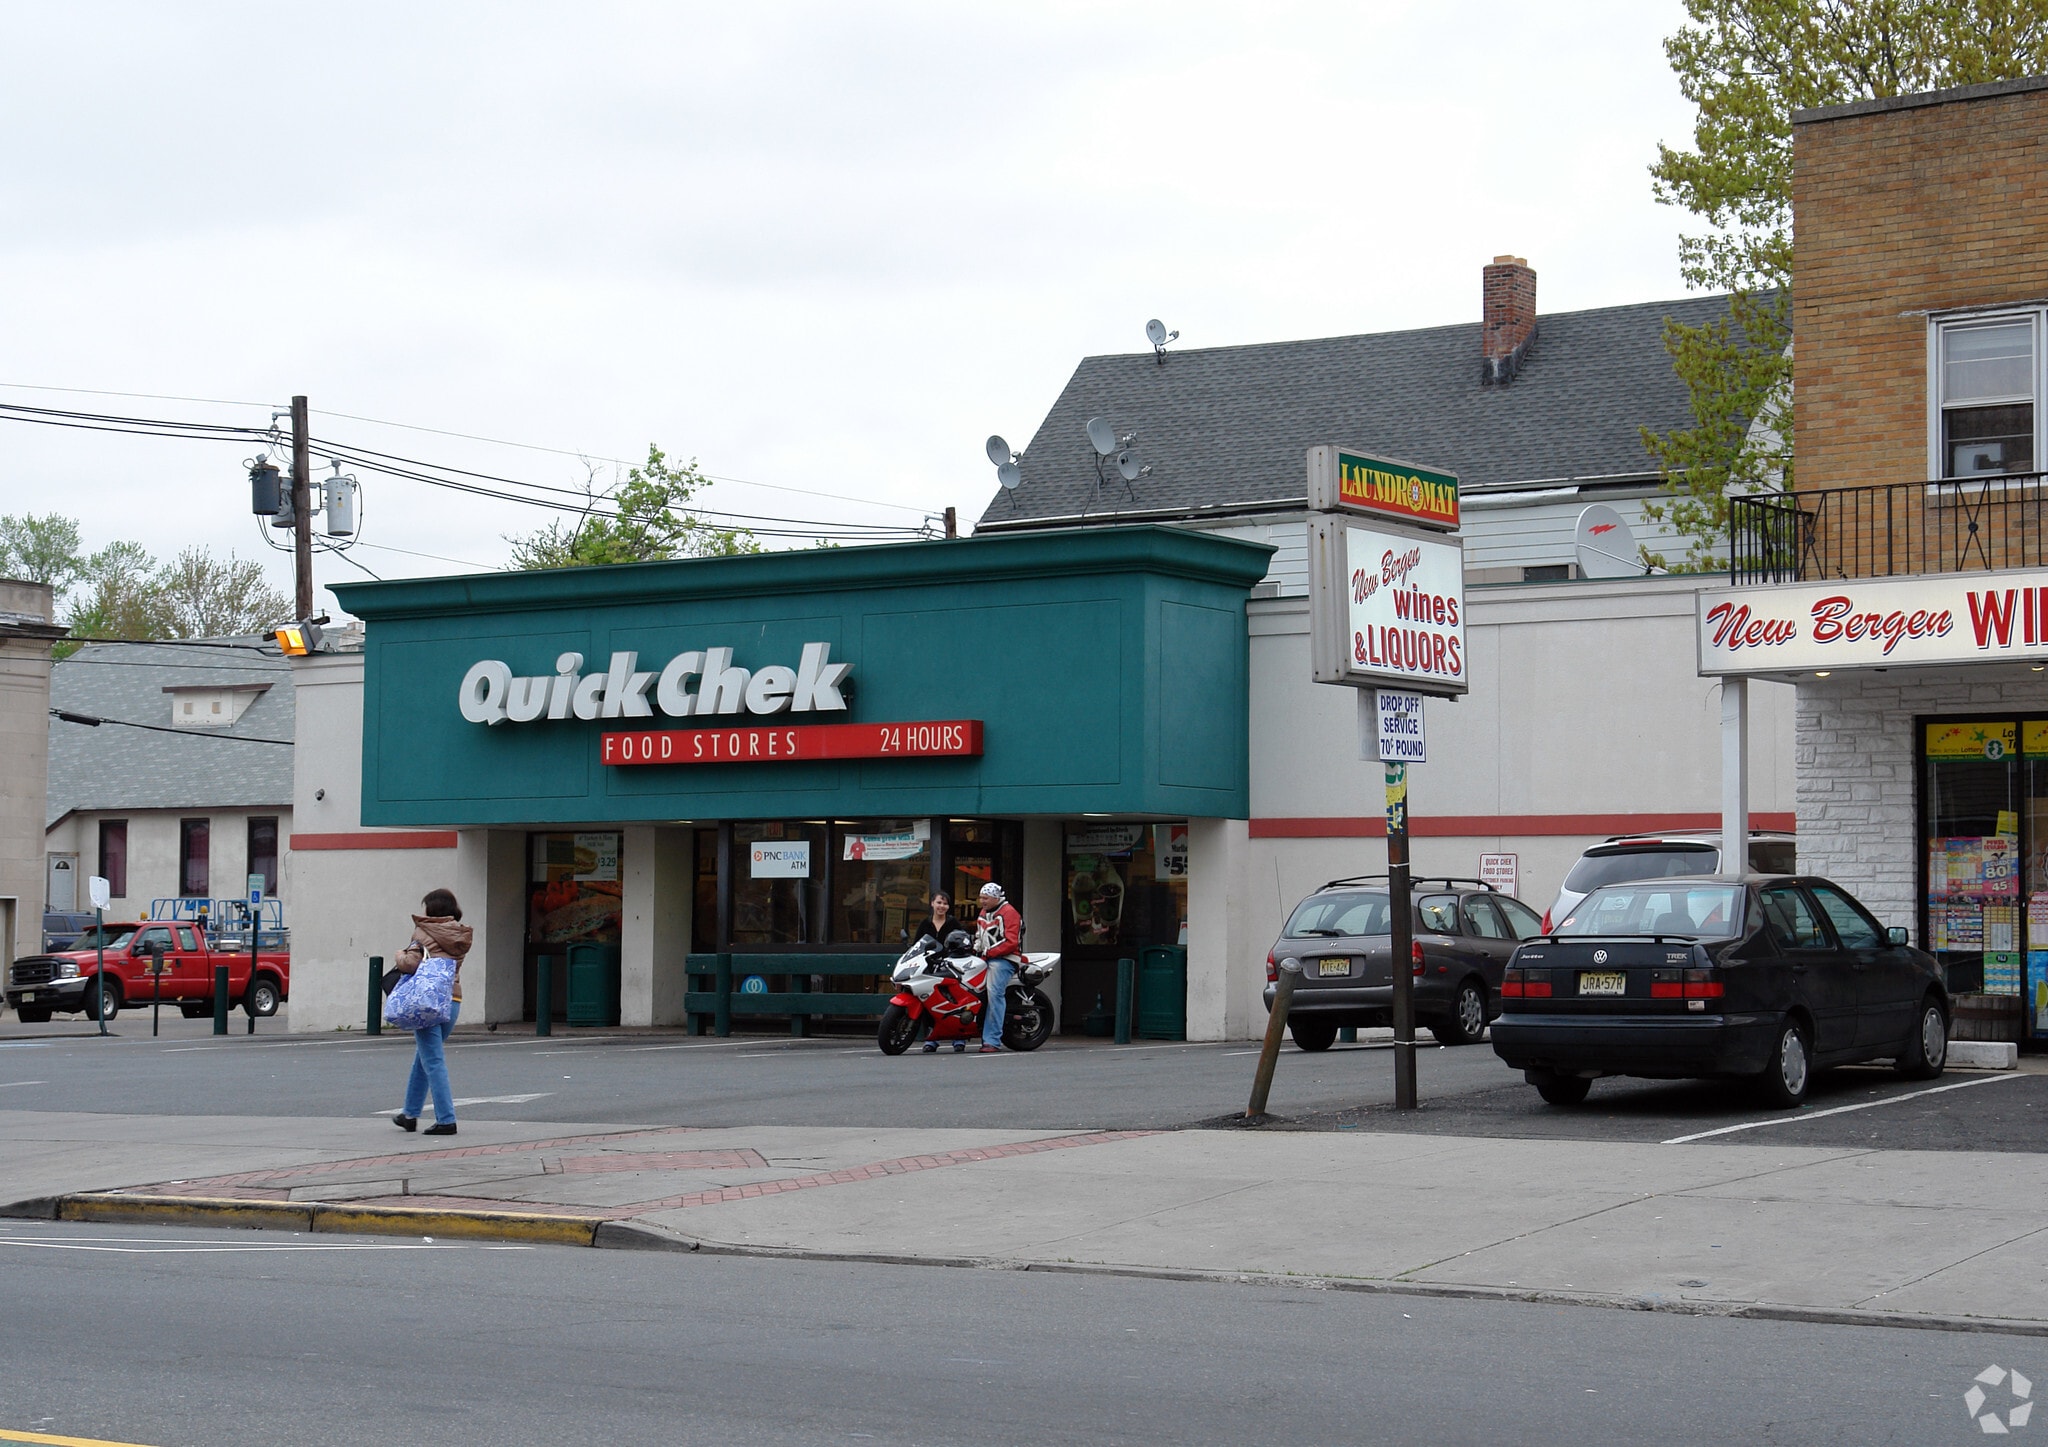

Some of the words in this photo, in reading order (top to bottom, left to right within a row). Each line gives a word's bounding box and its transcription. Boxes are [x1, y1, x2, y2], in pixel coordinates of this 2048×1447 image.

[1341, 463, 1457, 516] LAUNDROMAT
[1352, 568, 1379, 604] New
[1381, 547, 1421, 587] Bergen
[1393, 583, 1459, 627] wines
[1706, 602, 1797, 652] New
[1810, 596, 1953, 656] Bergen
[1380, 695, 1402, 711] DROP
[1405, 696, 1419, 713] OFF
[1384, 717, 1418, 734] SERVICE
[606, 735, 672, 760] FOOD
[694, 731, 796, 758] STORES
[880, 728, 901, 752] 24
[906, 725, 963, 751] HOURS
[1396, 739, 1423, 756] POUND
[763, 851, 782, 860] PNC
[783, 850, 806, 860] BANK
[1485, 858, 1498, 866] QUICK
[791, 861, 807, 869] ATM
